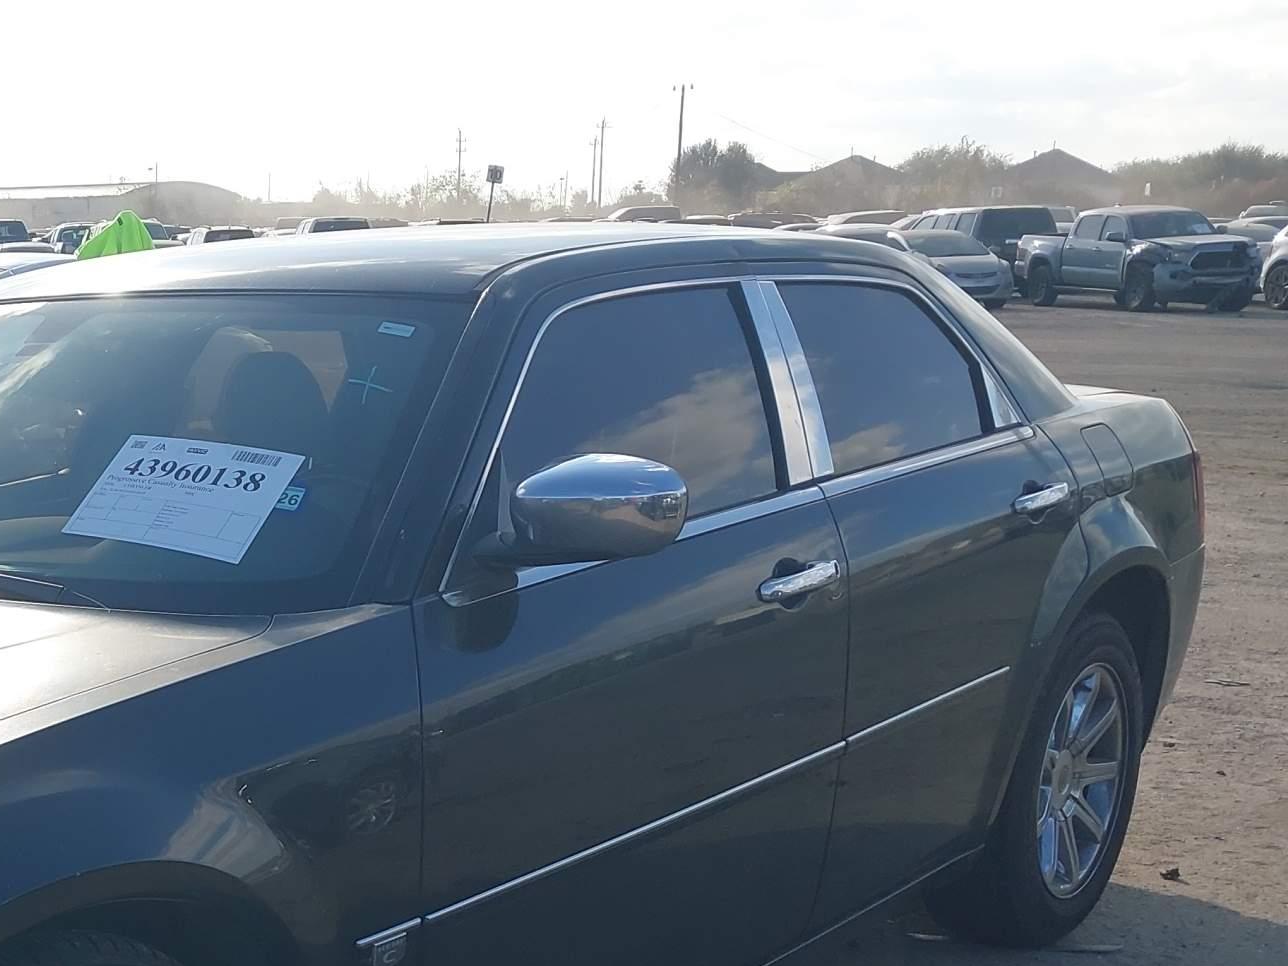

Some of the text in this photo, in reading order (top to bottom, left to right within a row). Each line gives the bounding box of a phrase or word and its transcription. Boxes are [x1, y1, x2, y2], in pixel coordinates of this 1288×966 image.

[124, 457, 266, 492] 43960138
[179, 482, 215, 493] Insurance
[276, 492, 300, 505] 26
